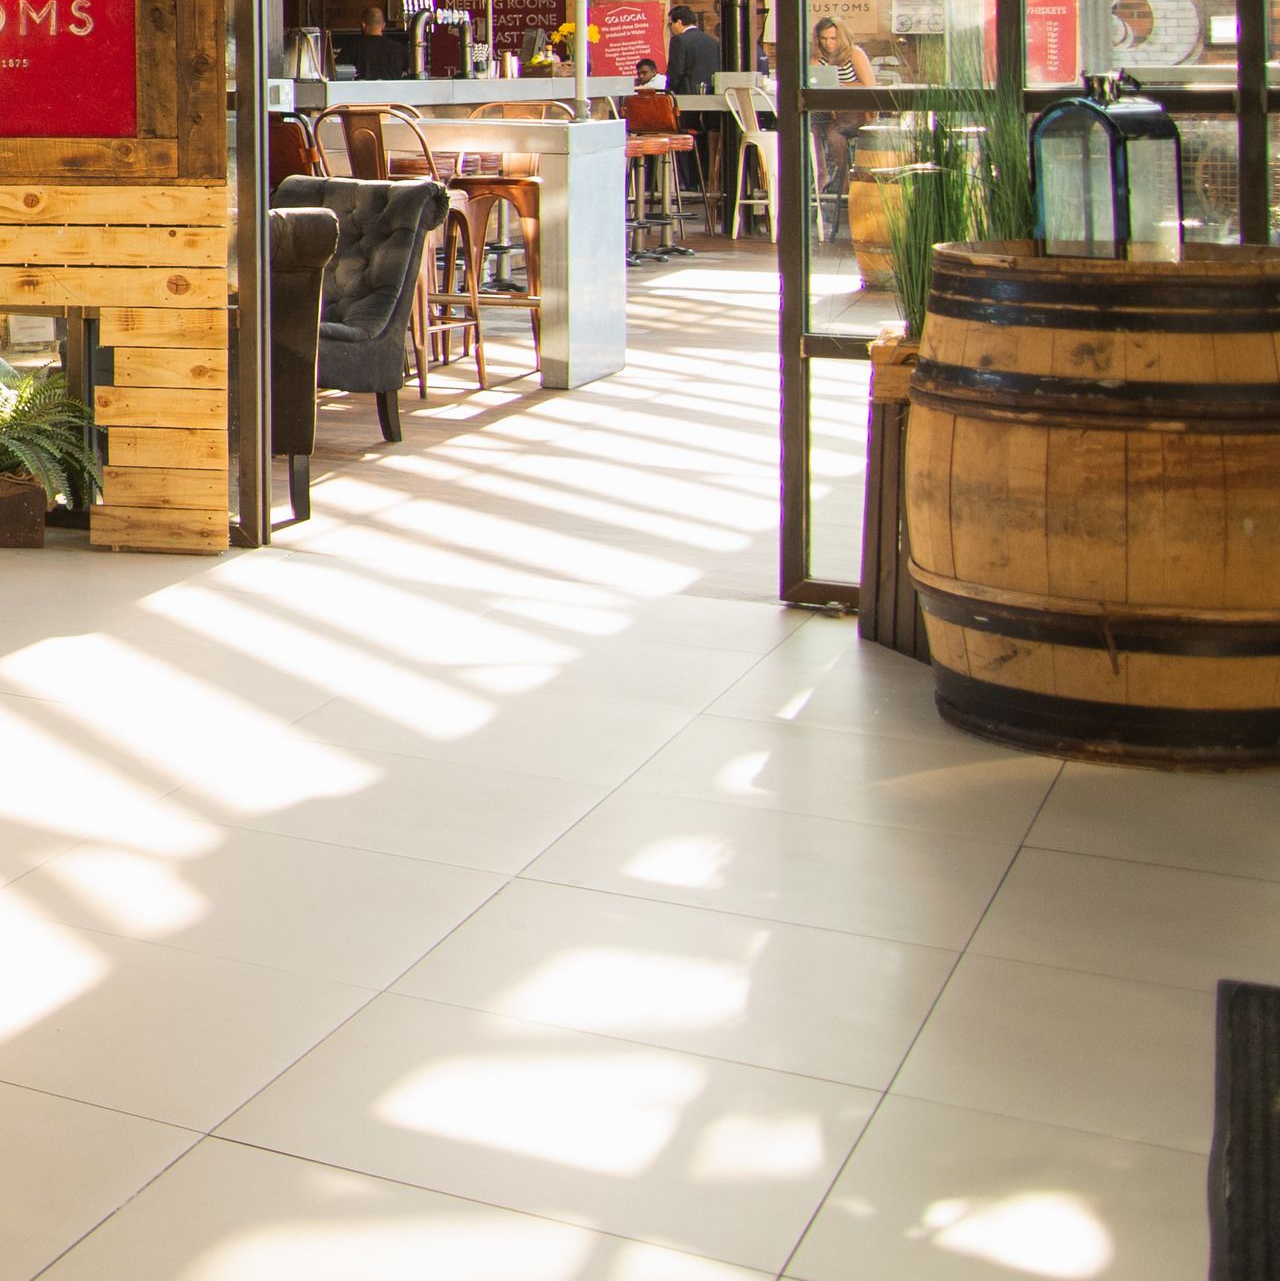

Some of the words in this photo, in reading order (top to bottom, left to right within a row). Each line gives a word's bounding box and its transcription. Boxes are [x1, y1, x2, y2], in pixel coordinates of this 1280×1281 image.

[808, 3, 870, 13] USTOMS
[492, 14, 522, 26] EAST
[526, 14, 557, 26] ONE
[605, 16, 619, 24] GO
[620, 13, 647, 23] LOCAL
[1, 58, 30, 69] 1875
